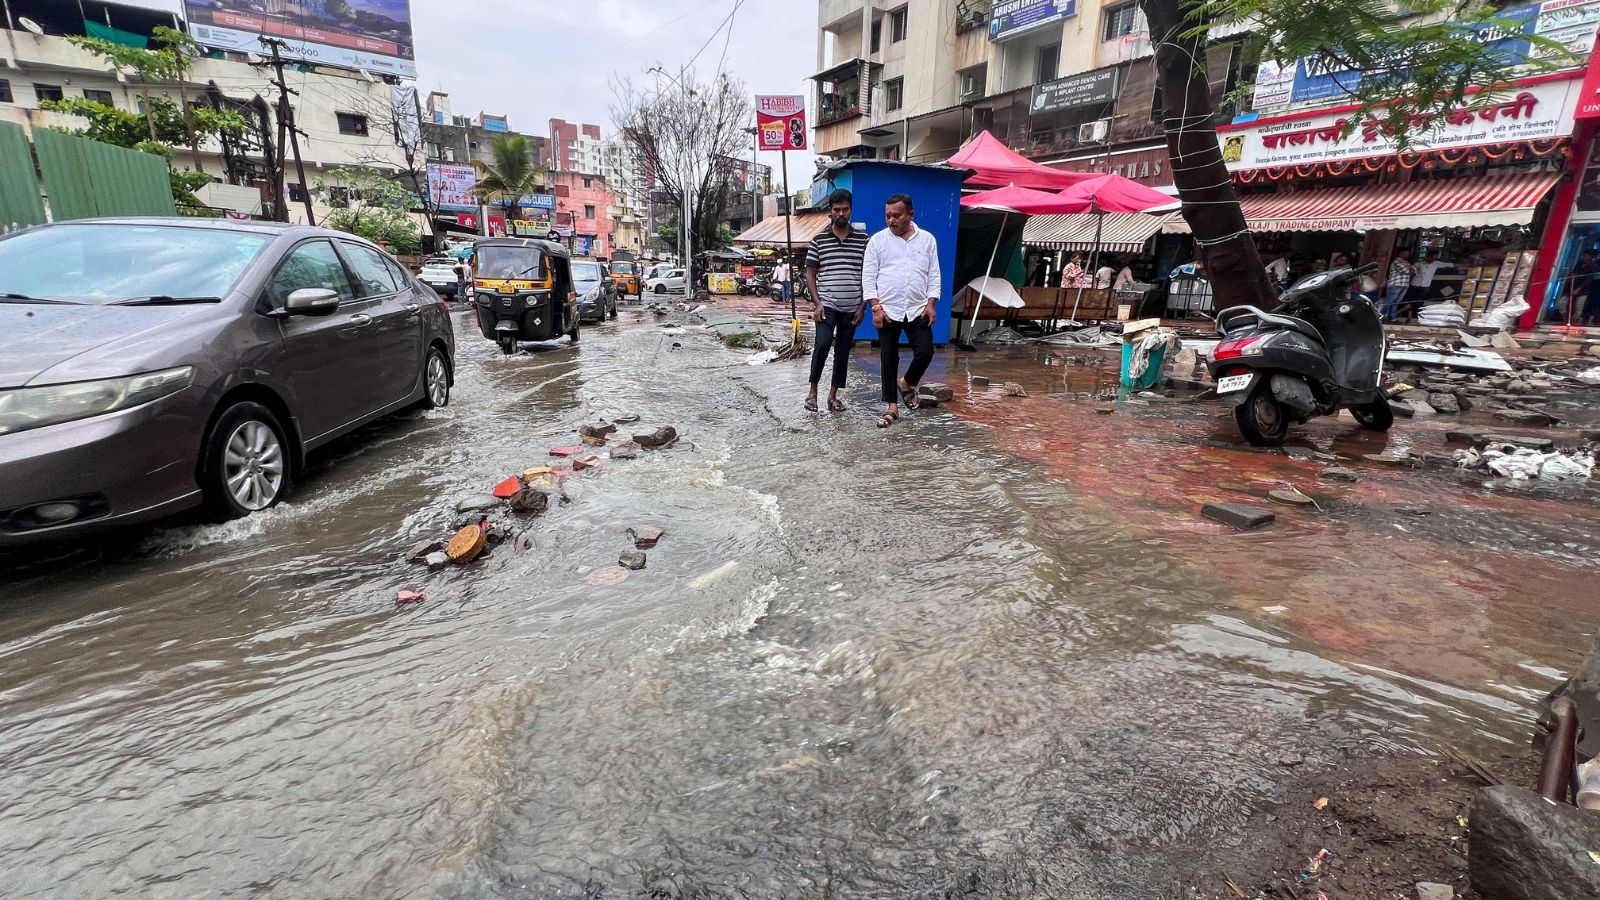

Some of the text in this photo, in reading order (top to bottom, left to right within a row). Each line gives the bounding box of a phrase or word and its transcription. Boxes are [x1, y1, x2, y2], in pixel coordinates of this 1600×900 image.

[993, 0, 1020, 18] ARUSHI
[1020, 0, 1042, 9] ENTE
[1543, 2, 1568, 12] HEALTH
[1562, 6, 1600, 19] Nuring
[1057, 79, 1080, 90] ADVANCED
[1080, 75, 1097, 84] DENTAL
[1097, 72, 1111, 81] CARE
[1058, 86, 1077, 96] IMPLANT
[1076, 83, 1095, 92] CENTRE
[1262, 118, 1349, 149] बालाजी
[532, 194, 552, 206] CLASSES
[1247, 221, 1270, 230] ALAJI
[1275, 221, 1312, 230] TRADING
[1311, 219, 1357, 229] COMPANY
